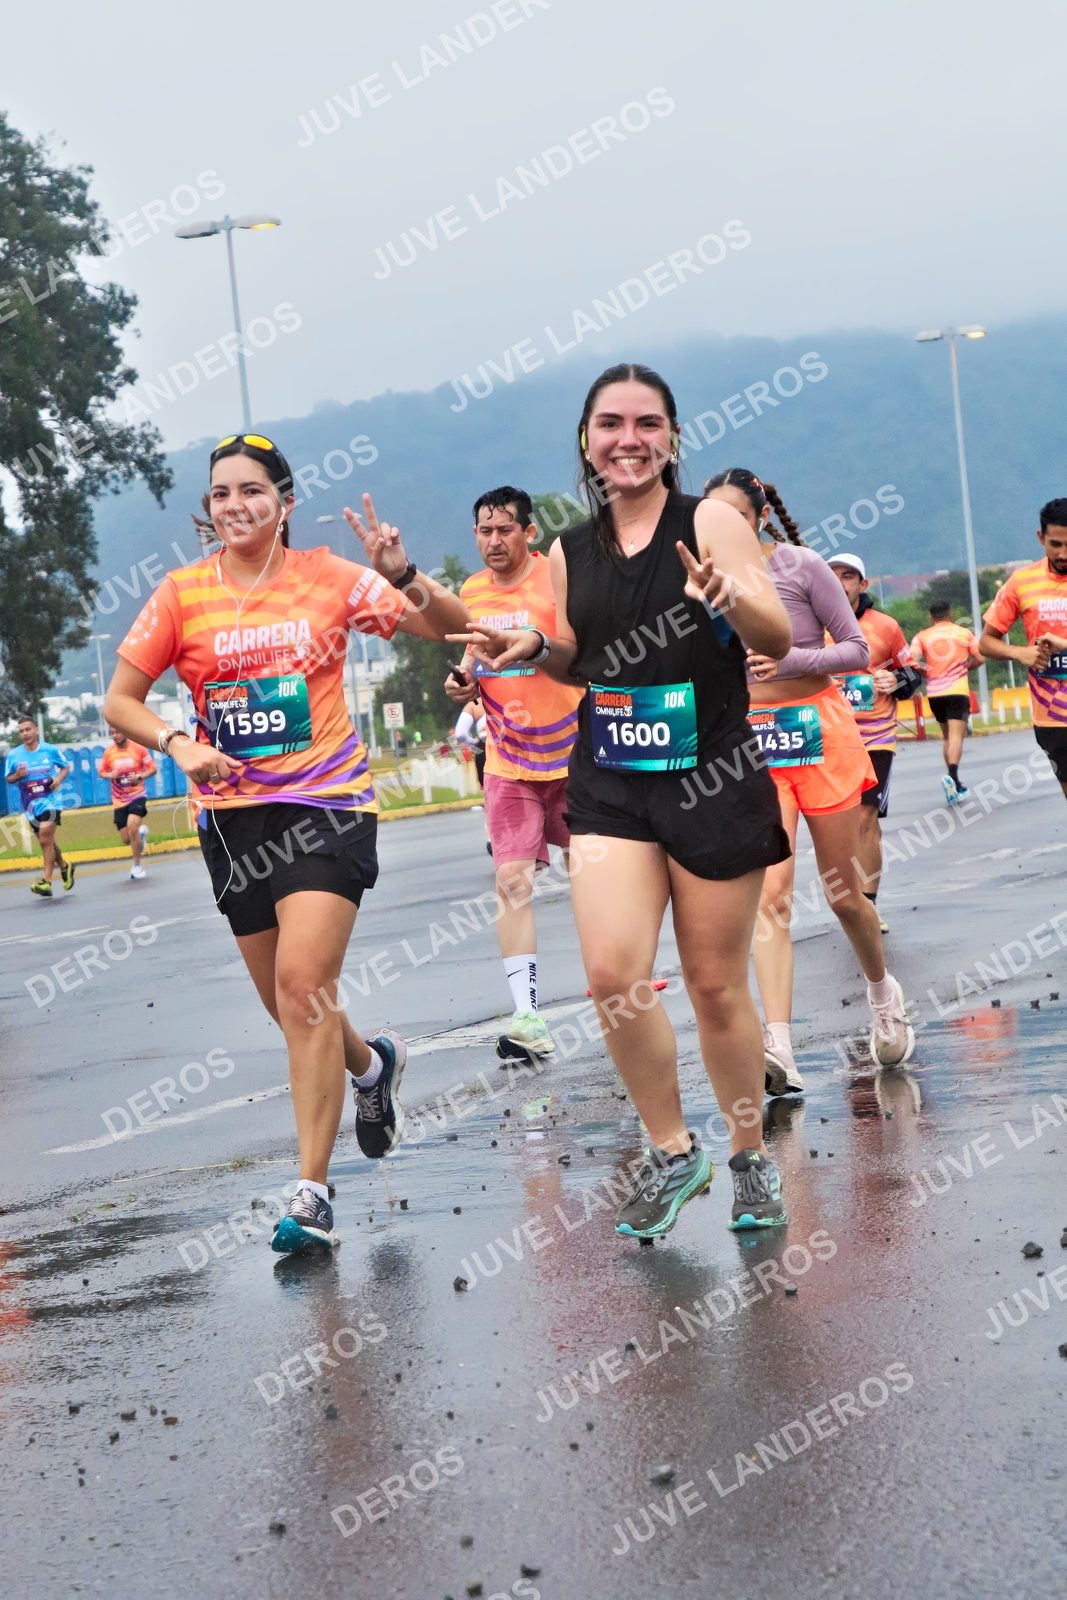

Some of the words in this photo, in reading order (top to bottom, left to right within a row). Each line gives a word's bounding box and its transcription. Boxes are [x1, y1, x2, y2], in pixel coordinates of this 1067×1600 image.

[214, 618, 311, 655] CARRERA
[277, 680, 298, 698] 10K
[841, 689, 862, 701] 49
[594, 692, 633, 706] CARRERA
[664, 690, 687, 709] 10K
[224, 709, 287, 736] 1599
[798, 709, 813, 722] 10K
[607, 721, 671, 746] 1600
[757, 731, 804, 751] 1435
[528, 962, 537, 985] NIKE
